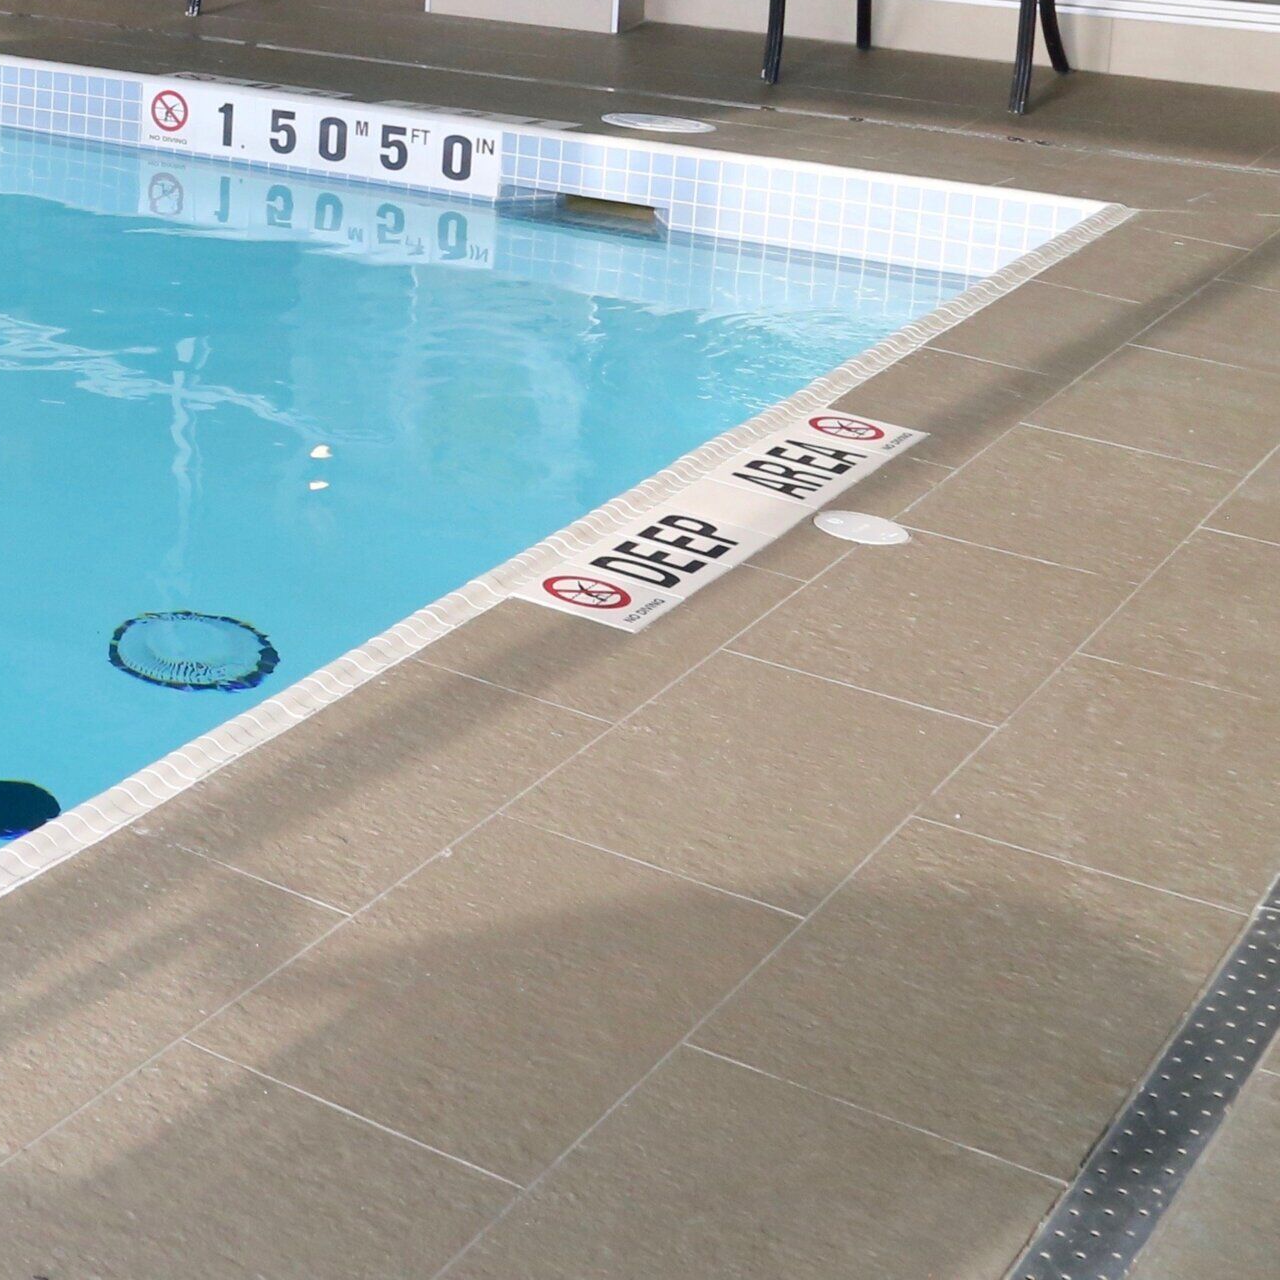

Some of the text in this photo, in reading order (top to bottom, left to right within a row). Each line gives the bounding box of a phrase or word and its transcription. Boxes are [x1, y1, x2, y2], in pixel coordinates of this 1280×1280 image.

[162, 136, 188, 145] DIVING
[588, 439, 869, 589] DEEP AREA
[623, 598, 666, 624] NO DIVING
